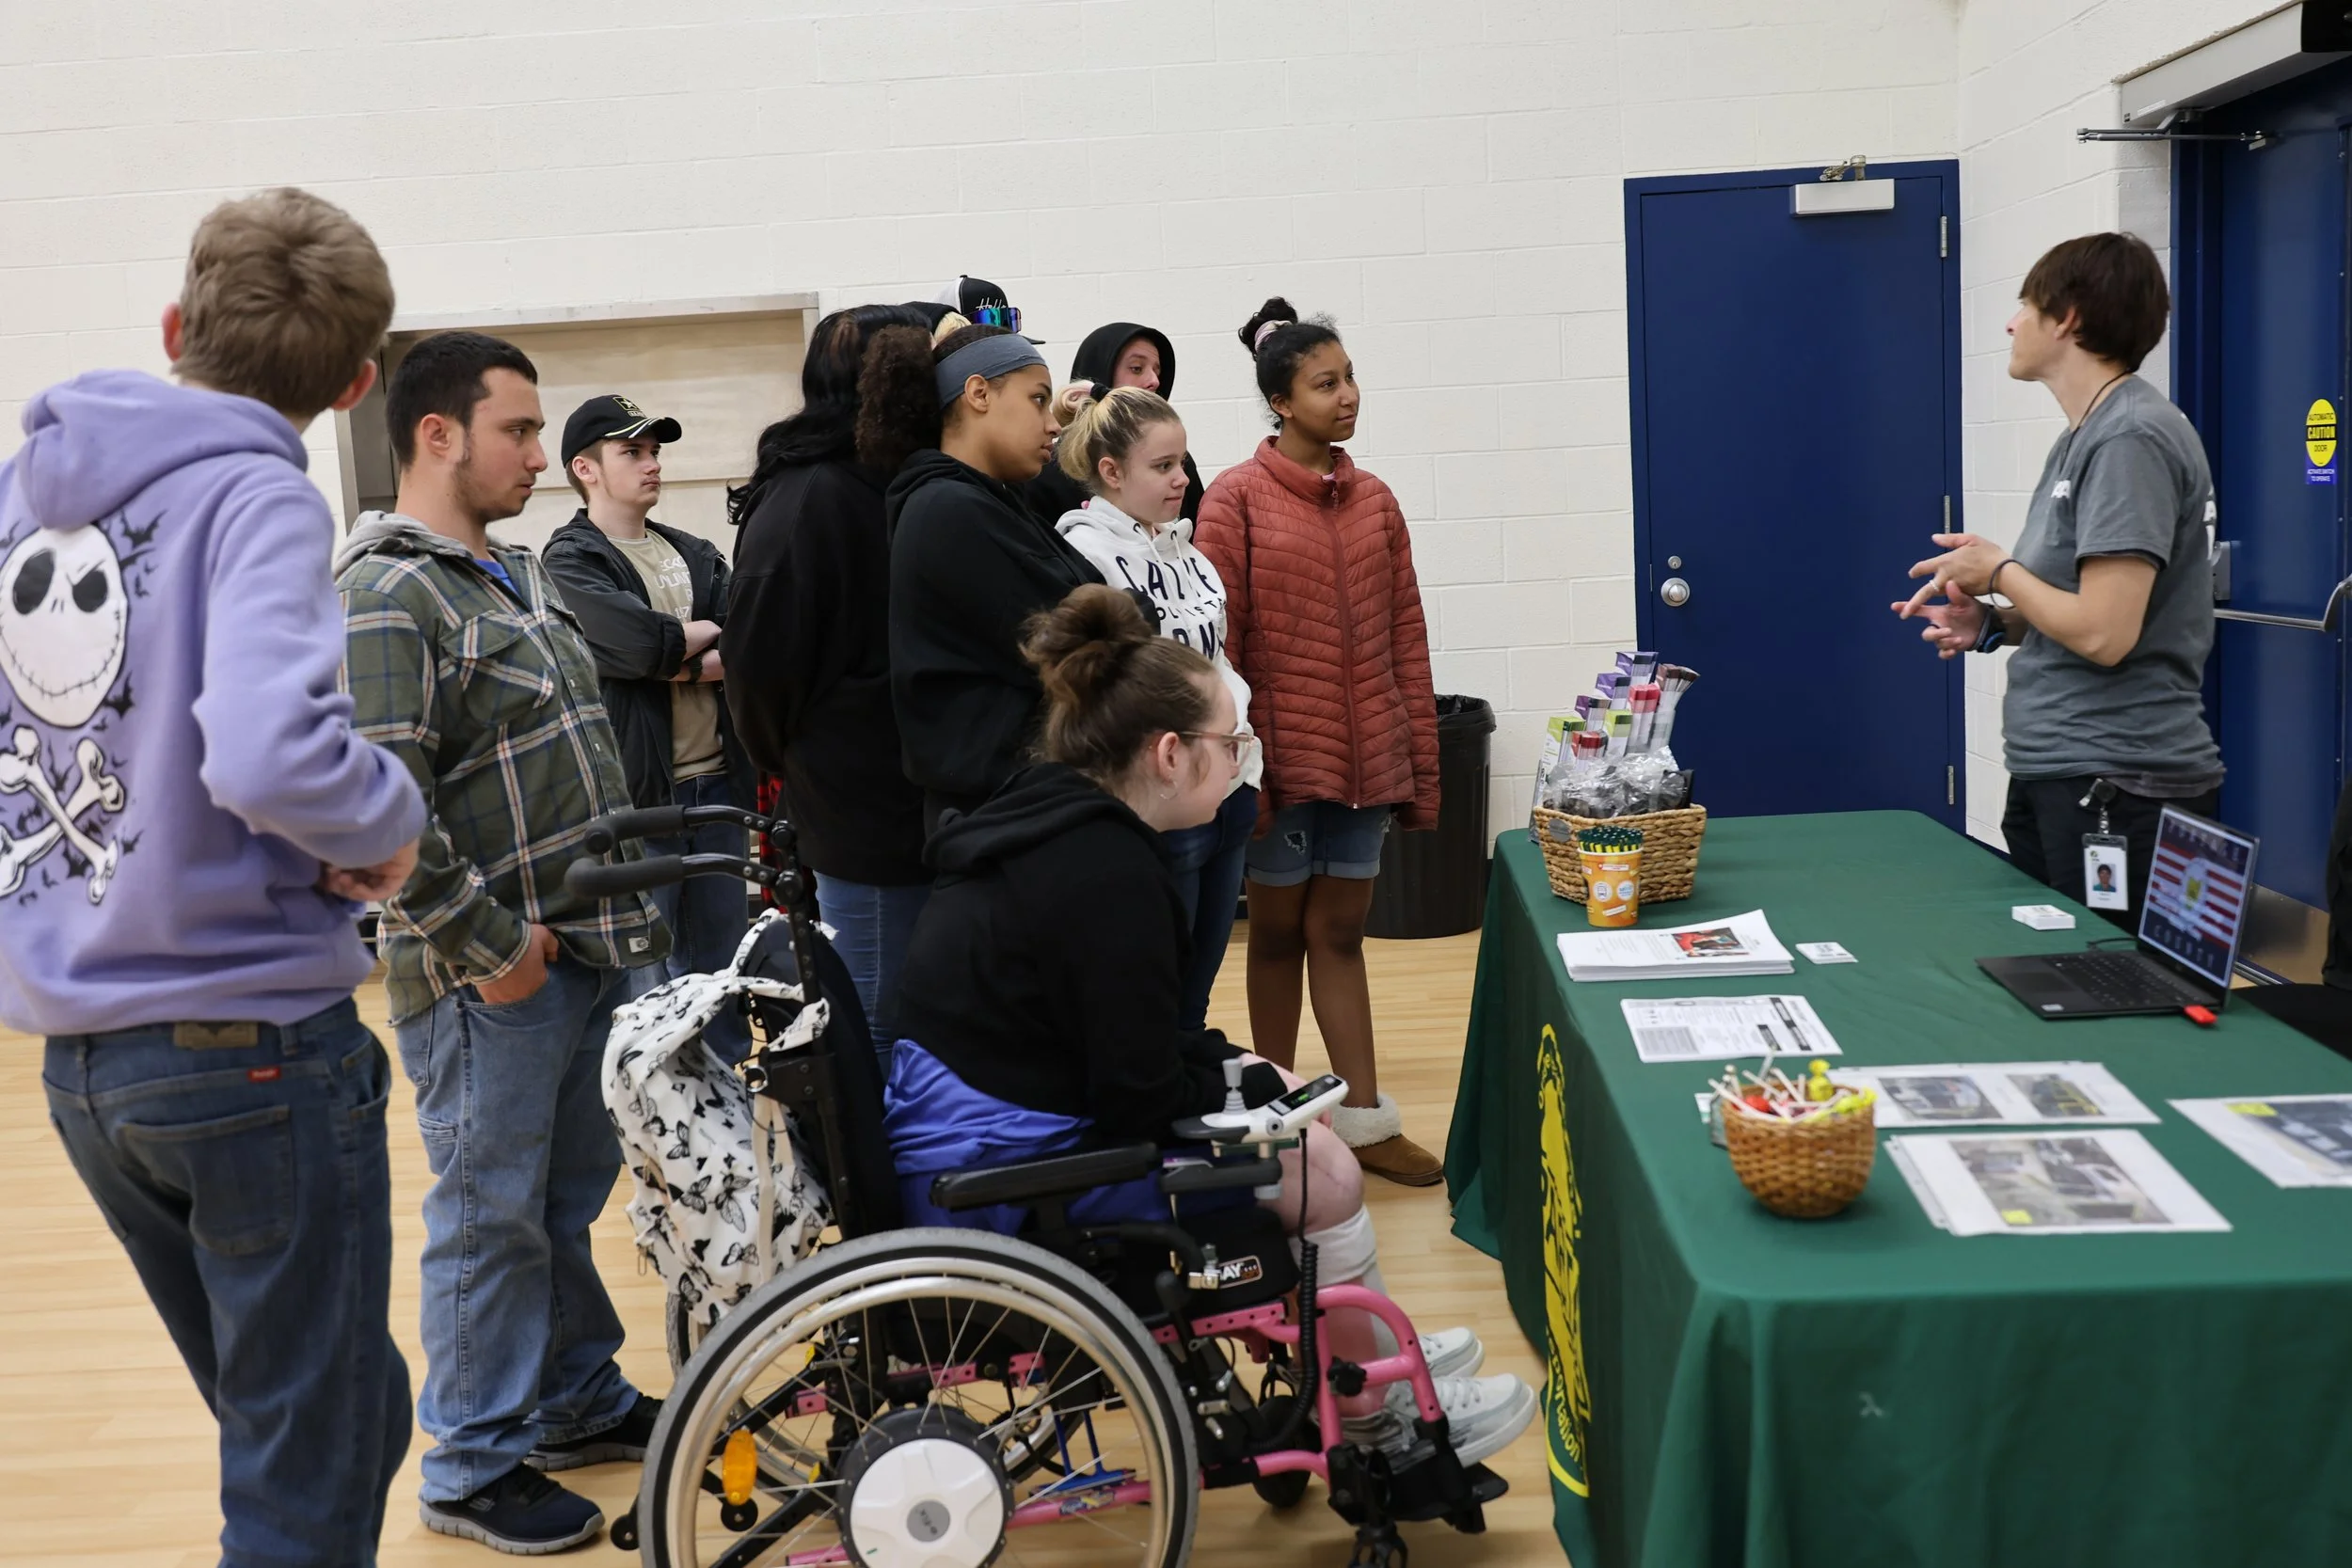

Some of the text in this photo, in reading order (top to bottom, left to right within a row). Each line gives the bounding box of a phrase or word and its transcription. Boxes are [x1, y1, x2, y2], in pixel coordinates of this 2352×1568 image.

[976, 297, 1007, 310] Hell
[1220, 1262, 1241, 1280] AY
[1546, 1325, 1581, 1463] portation
